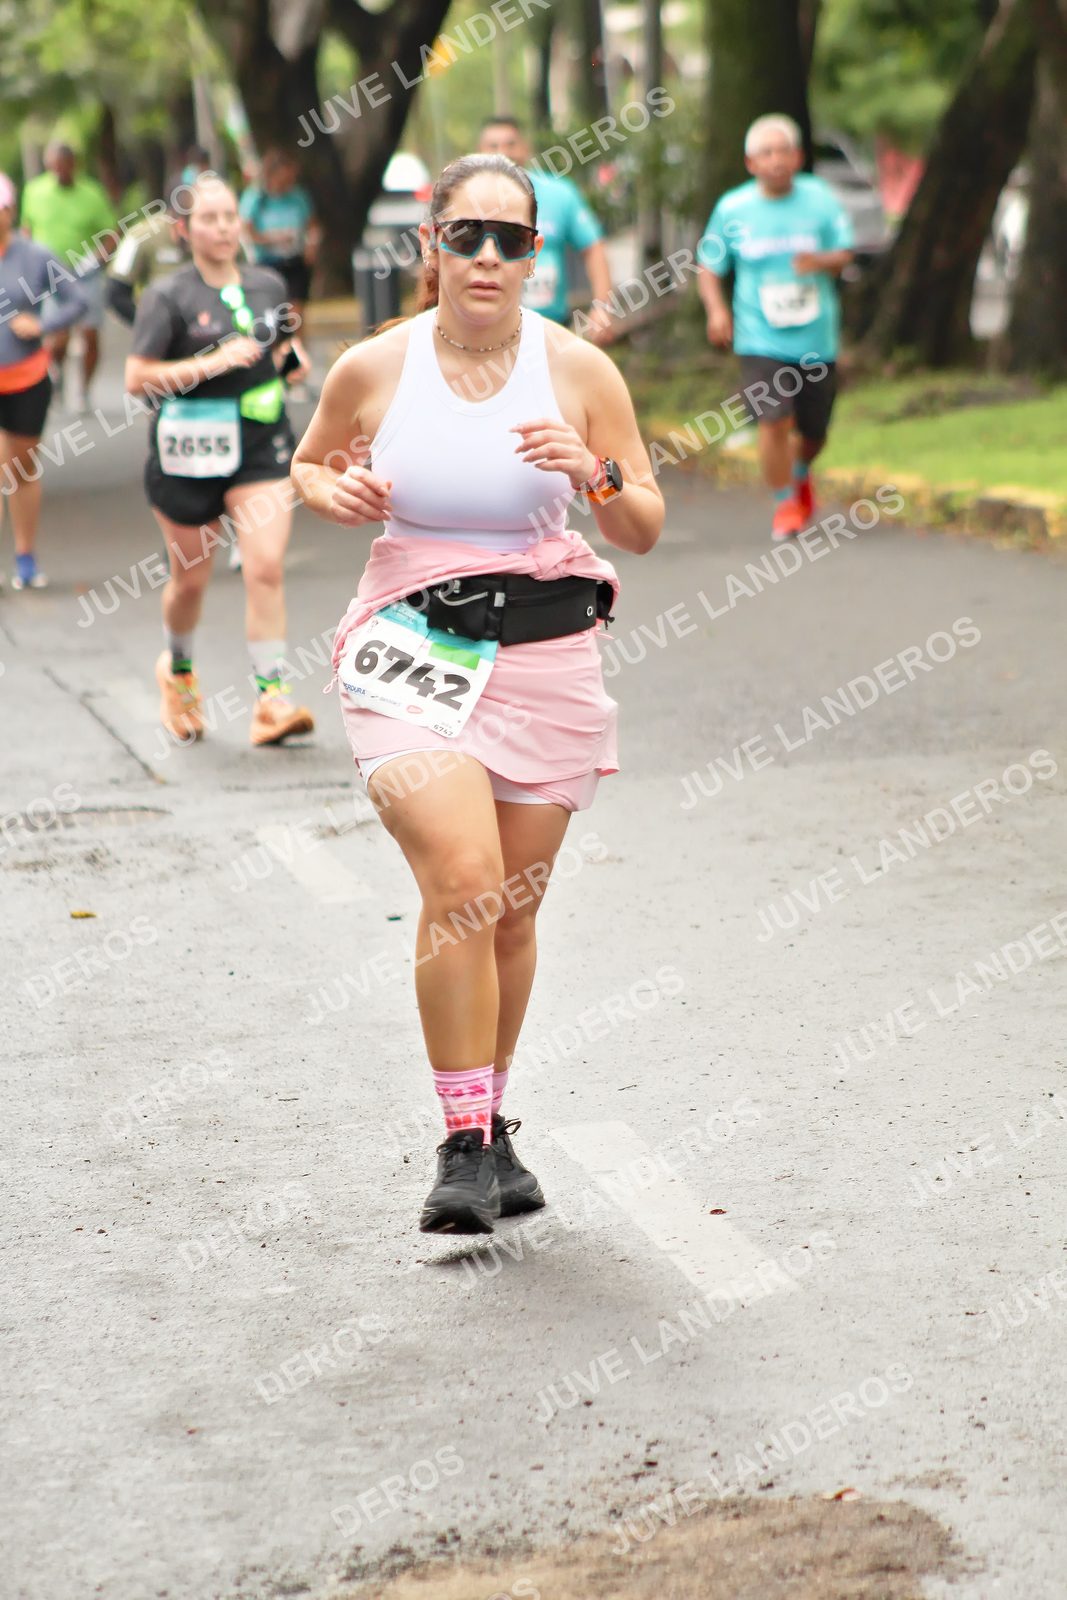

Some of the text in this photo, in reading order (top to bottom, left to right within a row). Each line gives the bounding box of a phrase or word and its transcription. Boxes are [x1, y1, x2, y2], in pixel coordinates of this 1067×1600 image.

[164, 436, 230, 457] 2655
[354, 639, 471, 711] 6742
[433, 723, 454, 736] 6742
